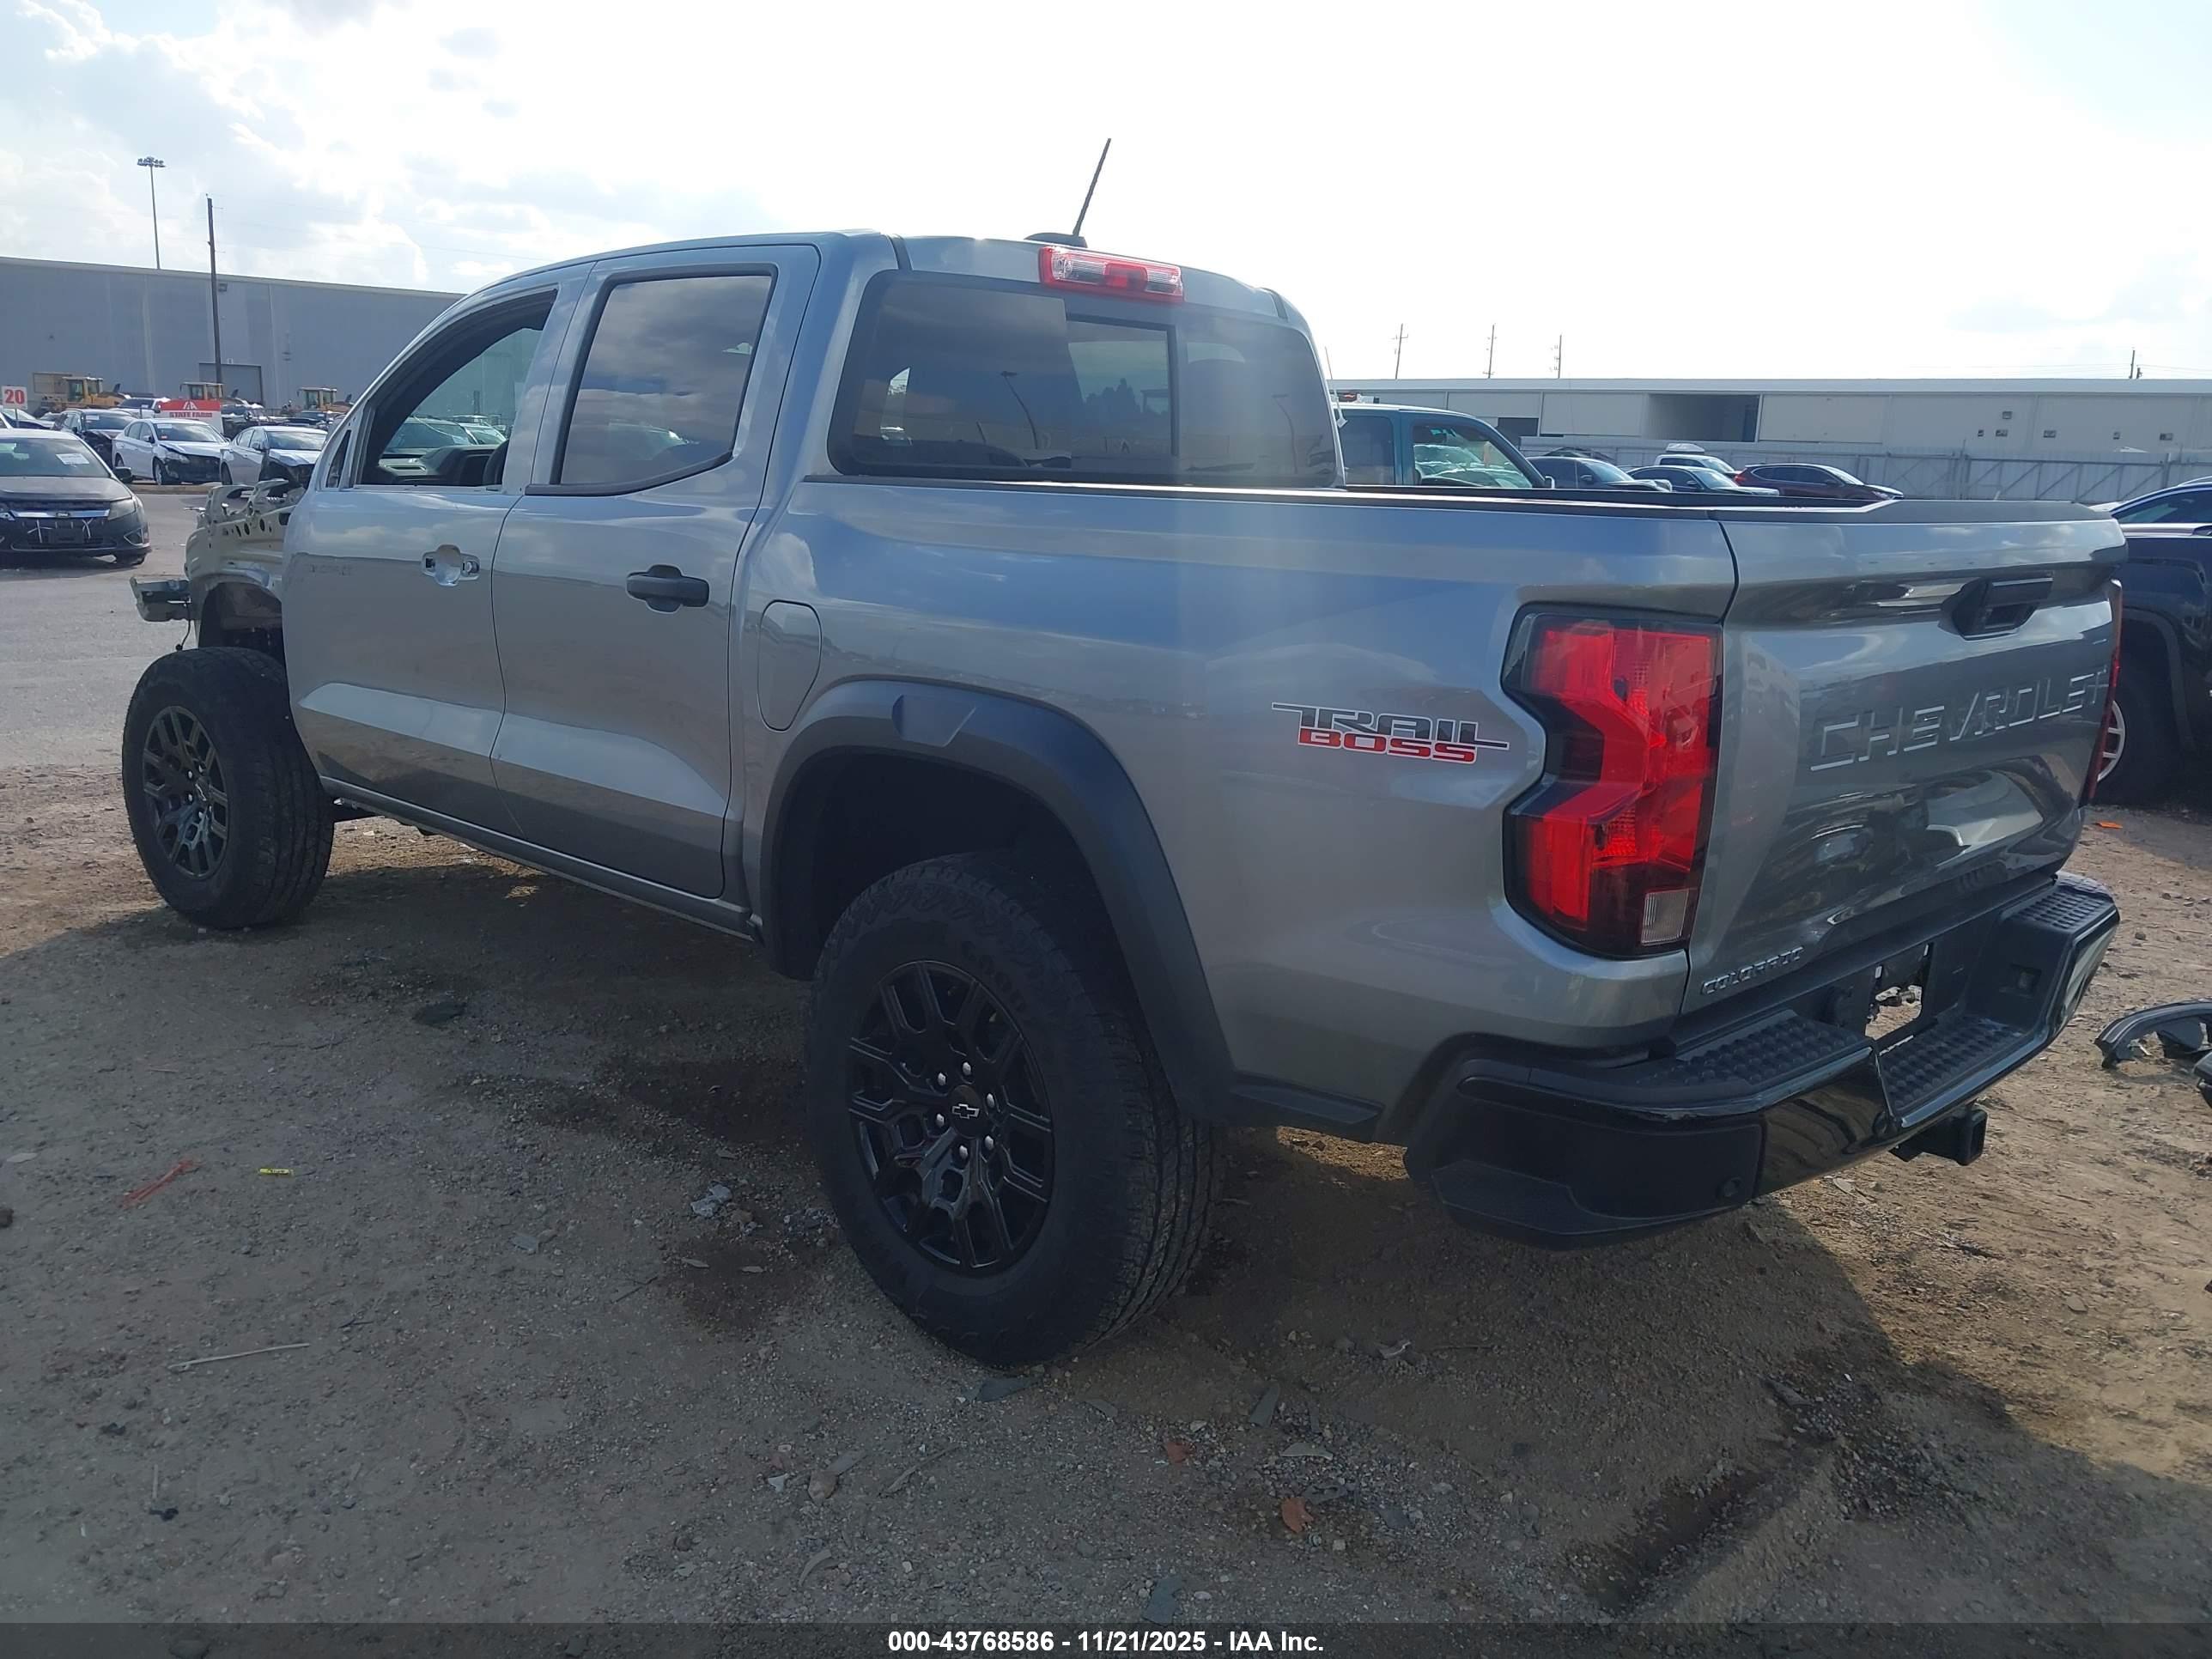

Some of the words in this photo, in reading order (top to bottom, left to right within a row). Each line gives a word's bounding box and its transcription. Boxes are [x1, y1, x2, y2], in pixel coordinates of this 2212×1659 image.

[4, 389, 25, 404] 20
[1271, 702, 1510, 750] TRAIL
[1810, 665, 2109, 771] CHEVROLET
[1297, 727, 1477, 764] BOSS
[1702, 946, 1803, 994] COLORADO
